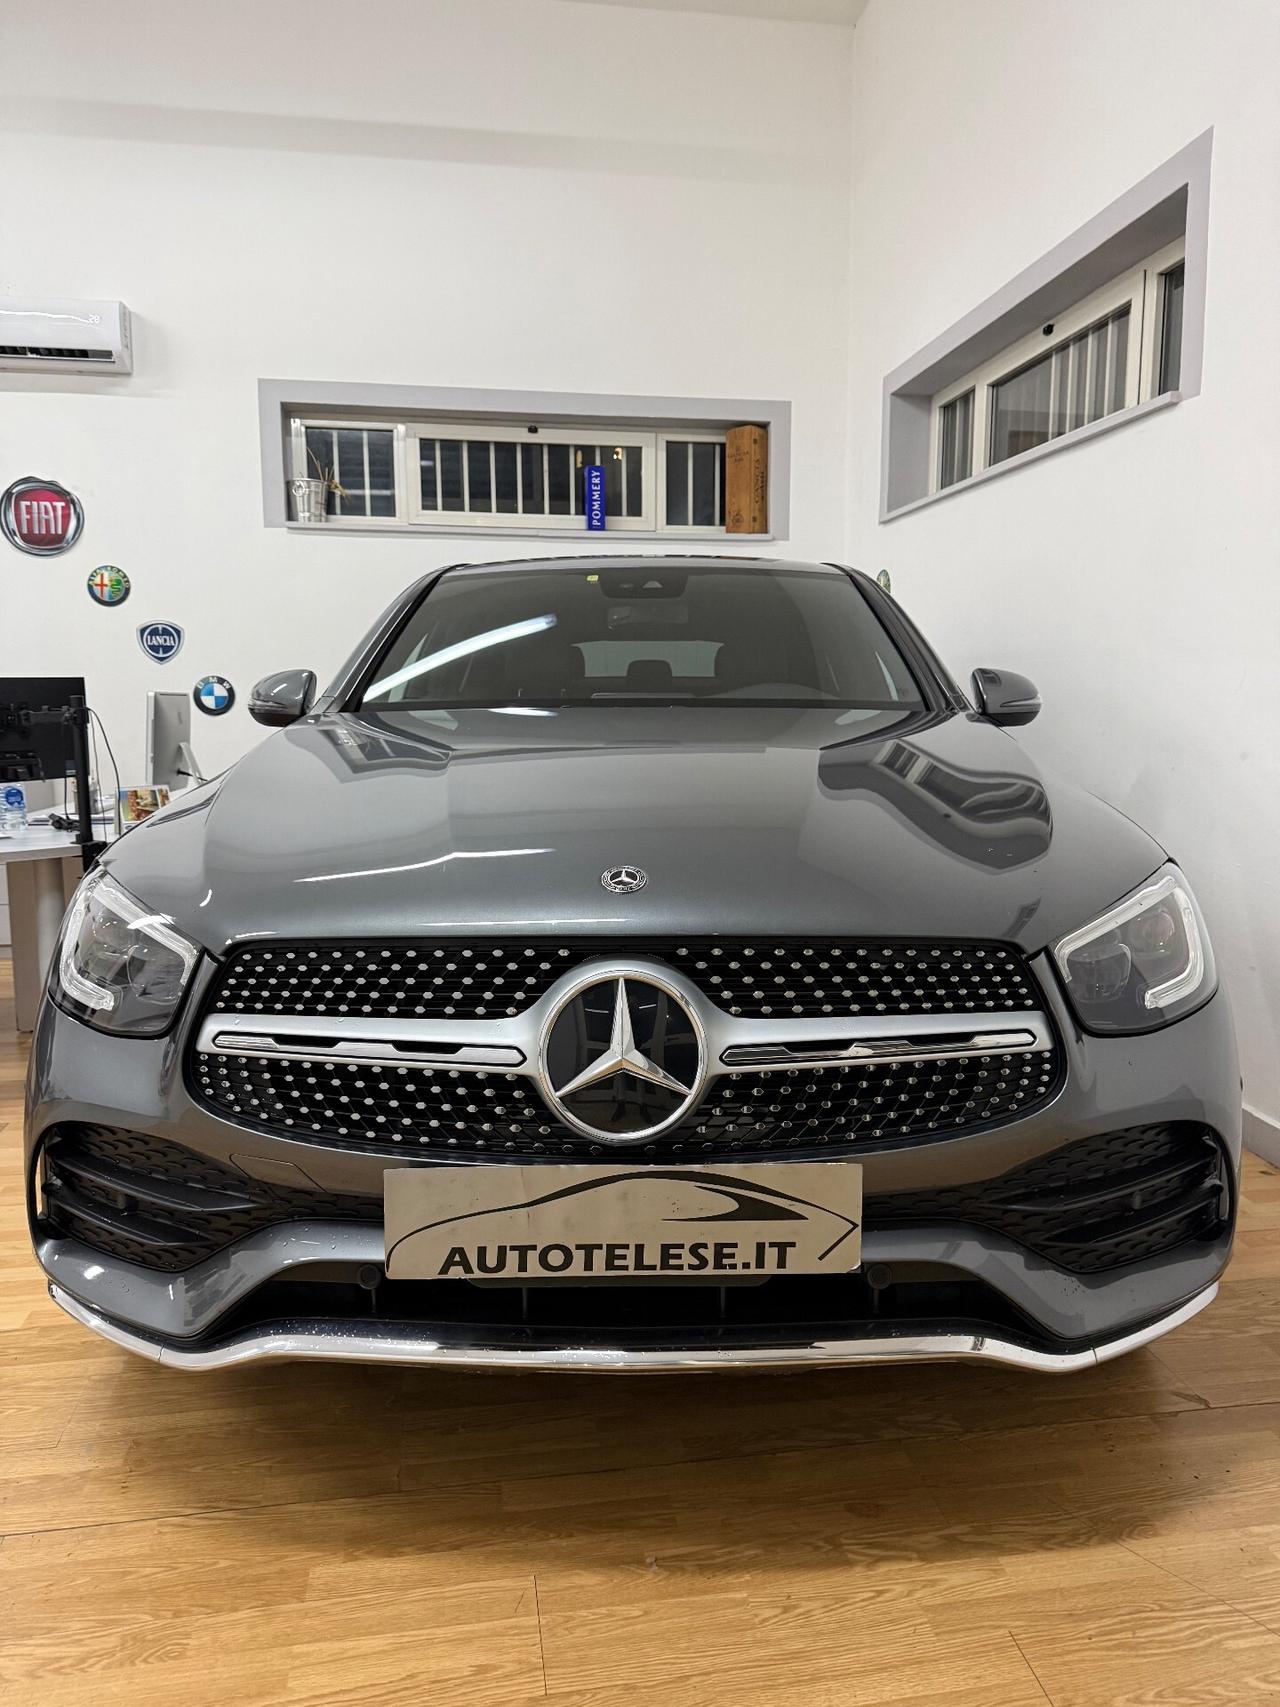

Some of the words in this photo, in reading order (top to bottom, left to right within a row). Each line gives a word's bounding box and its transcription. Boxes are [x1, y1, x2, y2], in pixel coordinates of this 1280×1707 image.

[592, 469, 602, 526] POMMERY
[20, 501, 66, 534] FIAT
[146, 635, 176, 646] LANCIA
[438, 1241, 797, 1275] AUTOTELESE.IT
